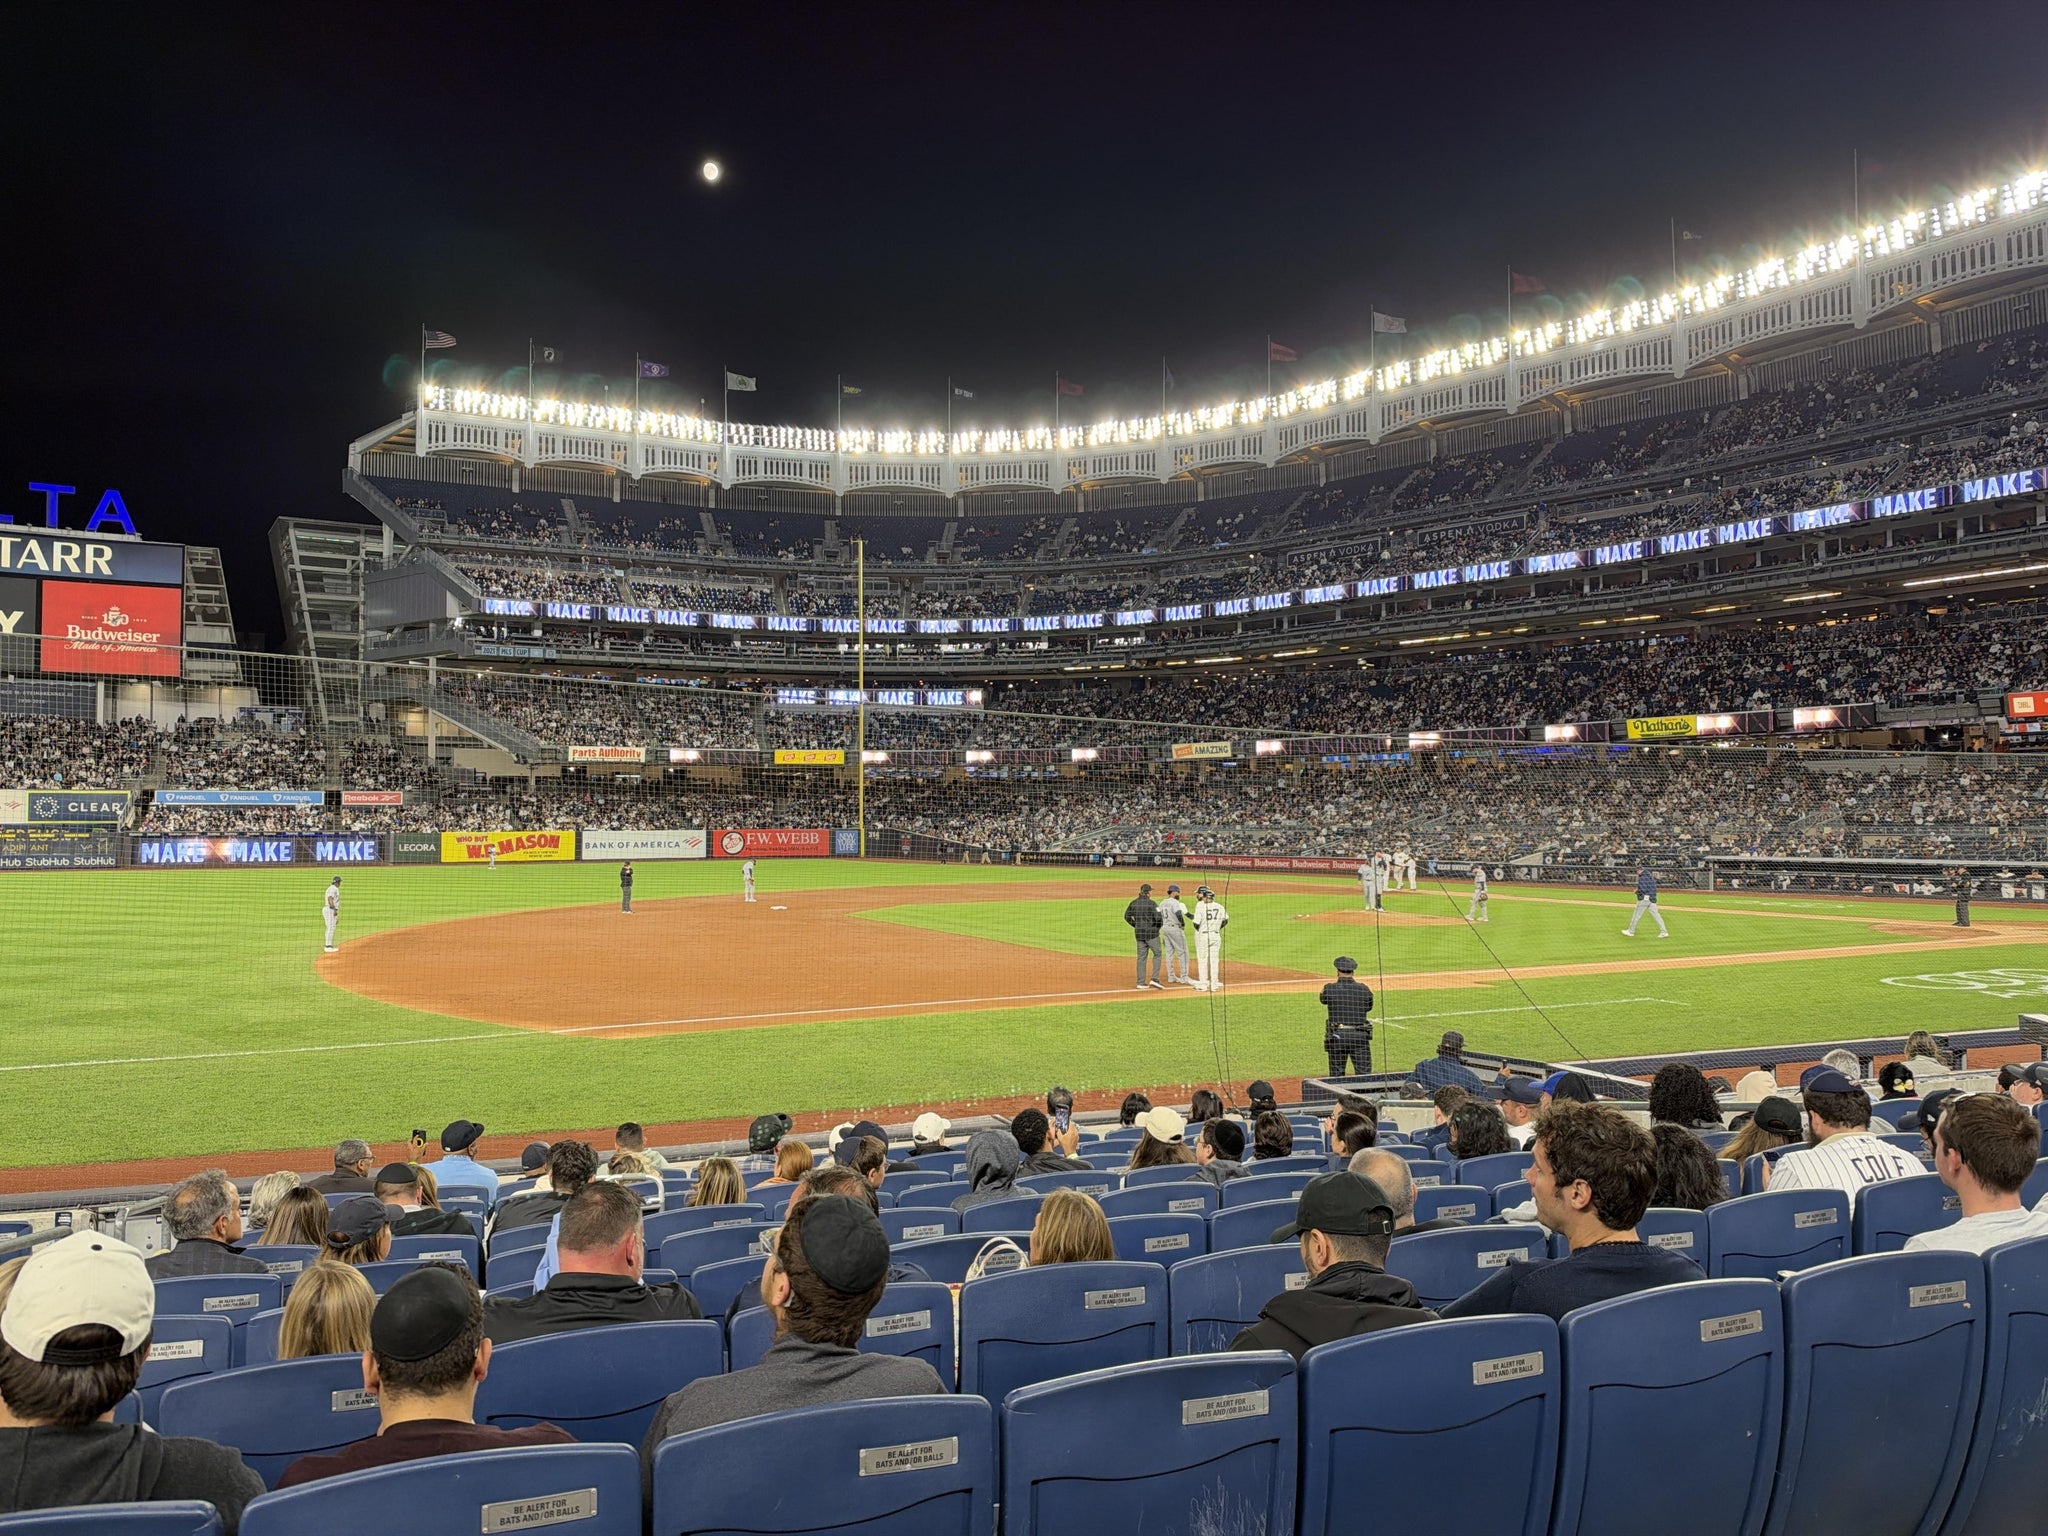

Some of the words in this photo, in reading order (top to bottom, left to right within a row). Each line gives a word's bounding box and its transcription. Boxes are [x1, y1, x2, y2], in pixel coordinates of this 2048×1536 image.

[0, 482, 136, 534] TA
[1478, 520, 1518, 532] VODKA
[548, 602, 590, 618] MAKE
[608, 605, 650, 622] MAKE
[657, 610, 697, 626] MAKE
[768, 617, 806, 631] MAKE
[822, 619, 860, 632] MAKE
[868, 620, 905, 633] MAKE
[972, 619, 1009, 632] MAKE
[1024, 616, 1060, 630] MAKE
[1066, 614, 1102, 629] MAKE
[1166, 604, 1200, 621] MAKE
[1215, 598, 1249, 615] MAKE
[1255, 592, 1291, 609] MAKE
[1357, 577, 1398, 596] MAKE
[1414, 568, 1458, 588] MAKE
[1466, 560, 1509, 582] MAKE
[1596, 541, 1642, 564] MAKE
[1661, 529, 1709, 553] MAKE
[1719, 518, 1771, 544] MAKE
[1875, 488, 1936, 517] MAKE
[1964, 470, 2033, 502] MAKE
[1339, 543, 1374, 556] VODKA
[66, 624, 160, 643] Budweiser
[64, 640, 100, 650] Made
[879, 692, 914, 704] MAKE
[928, 692, 962, 705] MAKE
[1633, 718, 1692, 732] Nathan's
[573, 749, 597, 757] Parts
[599, 748, 641, 758] Authority
[1195, 746, 1228, 754] AMAZING
[345, 794, 379, 802] Reebok
[68, 802, 121, 812] CLEAR
[776, 833, 819, 844] WEBB
[399, 843, 436, 852] LEGORA
[585, 841, 614, 849] BANK
[618, 841, 630, 849] OF
[141, 842, 205, 863] MAKE
[230, 842, 291, 862] MAKE
[316, 841, 374, 861] MAKE
[26, 857, 69, 866] StubHub
[74, 857, 116, 866] StubHub
[1184, 856, 1216, 865] Budweiser
[1254, 859, 1290, 868] Budweiser
[1293, 859, 1330, 869] Budweiser
[1333, 861, 1360, 870] Budweis
[1206, 909, 1219, 920] 67
[1499, 1368, 1517, 1376] AND/OR
[1216, 1400, 1233, 1408] ALERT
[1213, 1407, 1236, 1416] AND/OR
[1238, 1404, 1255, 1412] BALLS
[888, 1451, 896, 1459] BE
[898, 1448, 918, 1457] ALERT
[895, 1456, 921, 1465] AND/OR
[924, 1453, 944, 1462] BALLS
[514, 1505, 524, 1514] BE
[526, 1502, 549, 1512] ALERT
[552, 1499, 566, 1507] FOR
[500, 1516, 520, 1526] BATS
[522, 1510, 554, 1522] AND/OR
[556, 1506, 579, 1516] BALLS
